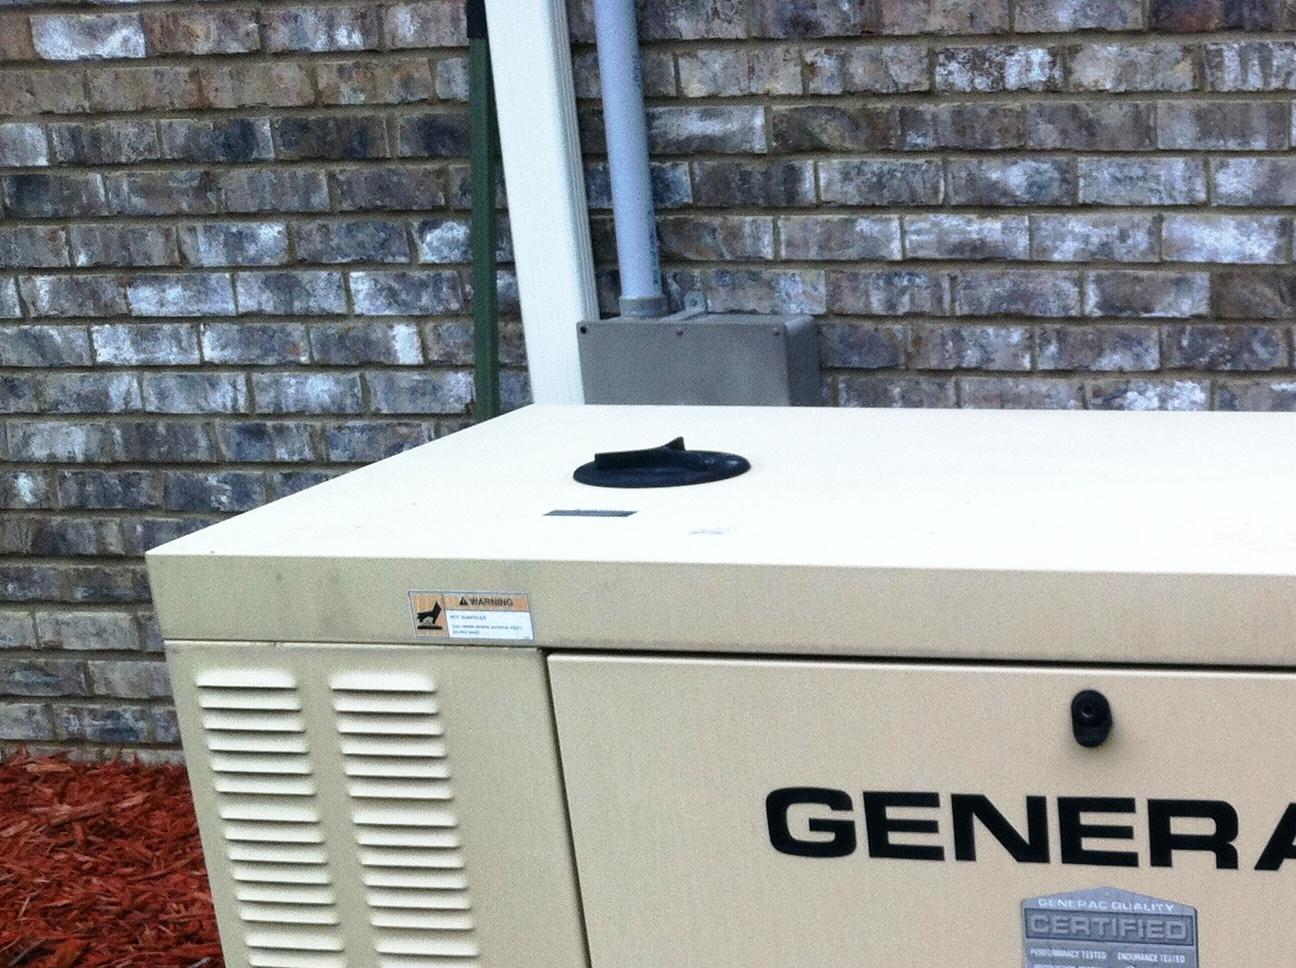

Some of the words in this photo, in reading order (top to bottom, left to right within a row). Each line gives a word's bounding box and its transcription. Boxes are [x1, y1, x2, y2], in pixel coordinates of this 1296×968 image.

[469, 597, 514, 606] WARNING
[1037, 897, 1108, 910] GENERAC
[1111, 900, 1175, 913] QUALITY
[1030, 914, 1188, 940] CERTIFIED
[1081, 949, 1107, 960] TESTED
[1160, 953, 1186, 964] TESTED
